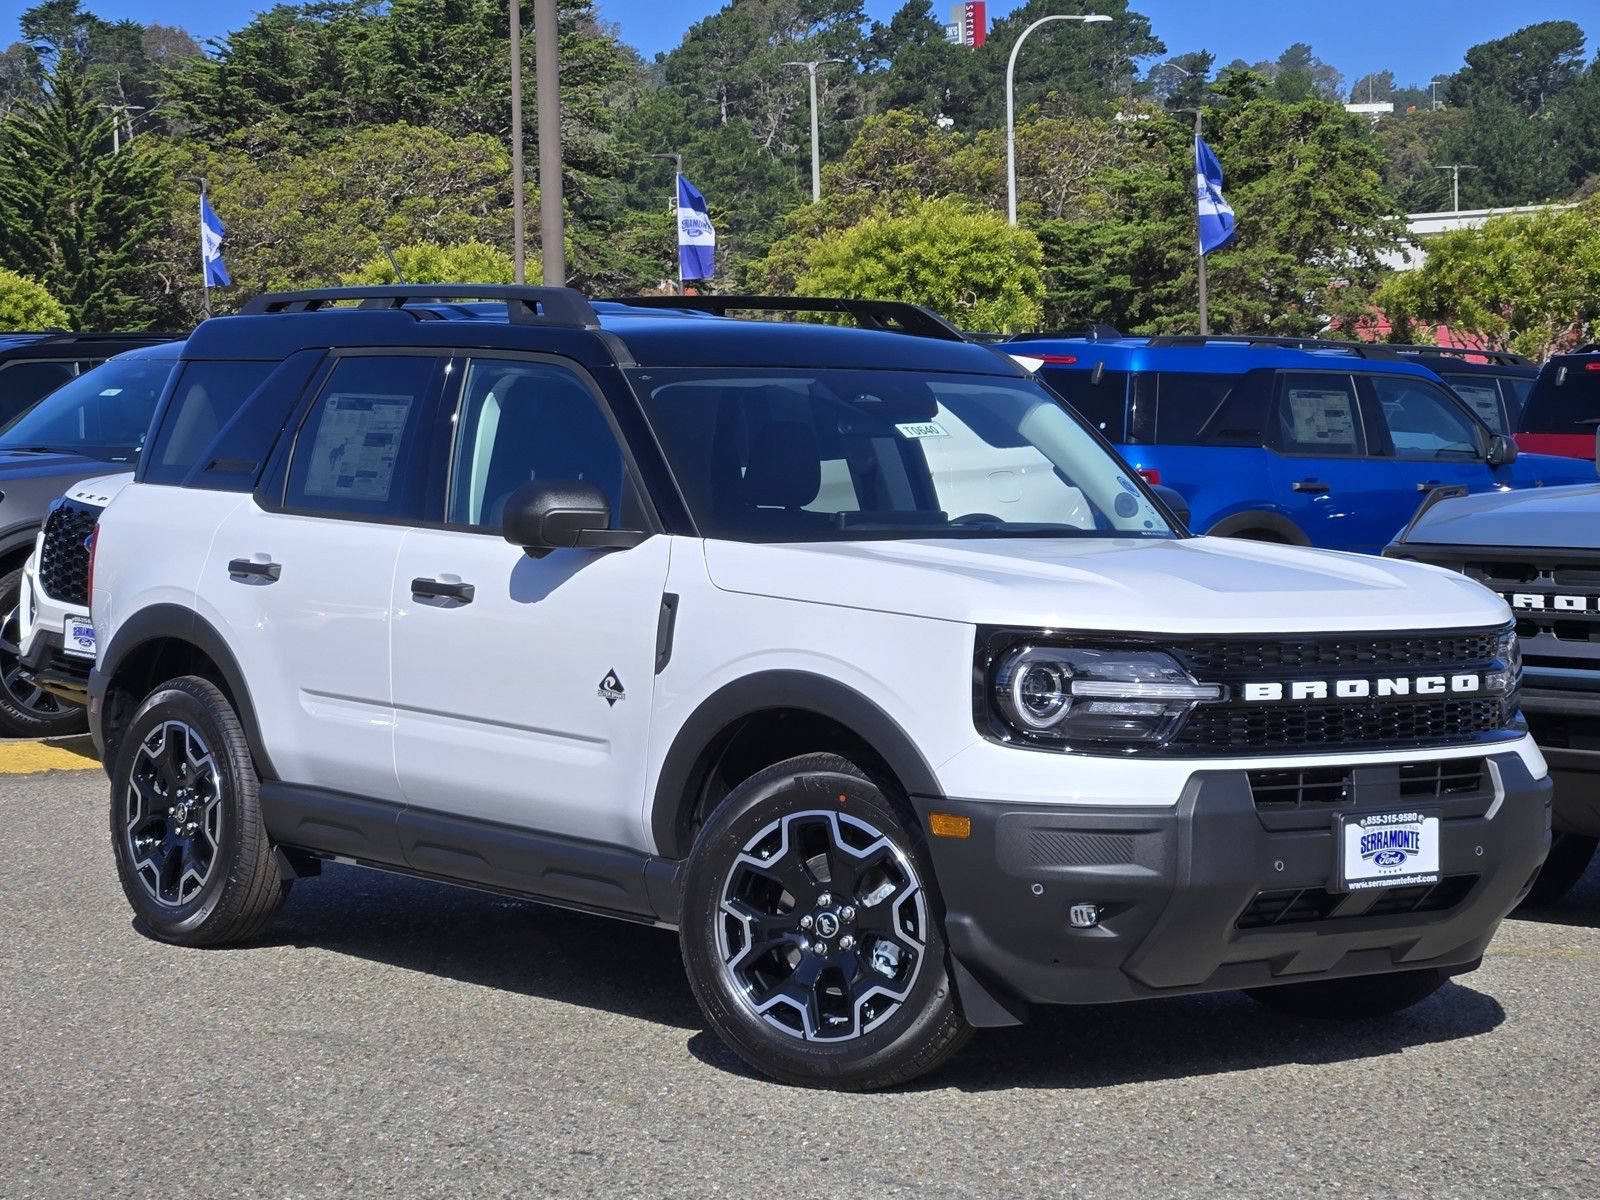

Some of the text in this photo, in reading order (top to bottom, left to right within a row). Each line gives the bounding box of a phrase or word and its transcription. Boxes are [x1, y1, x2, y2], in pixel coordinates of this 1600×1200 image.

[1245, 674, 1480, 701] BRONCO
[1360, 830, 1420, 855] SERRAMONTE
[1378, 851, 1402, 866] Ford
[1348, 875, 1438, 891] www.serramonteford.com
